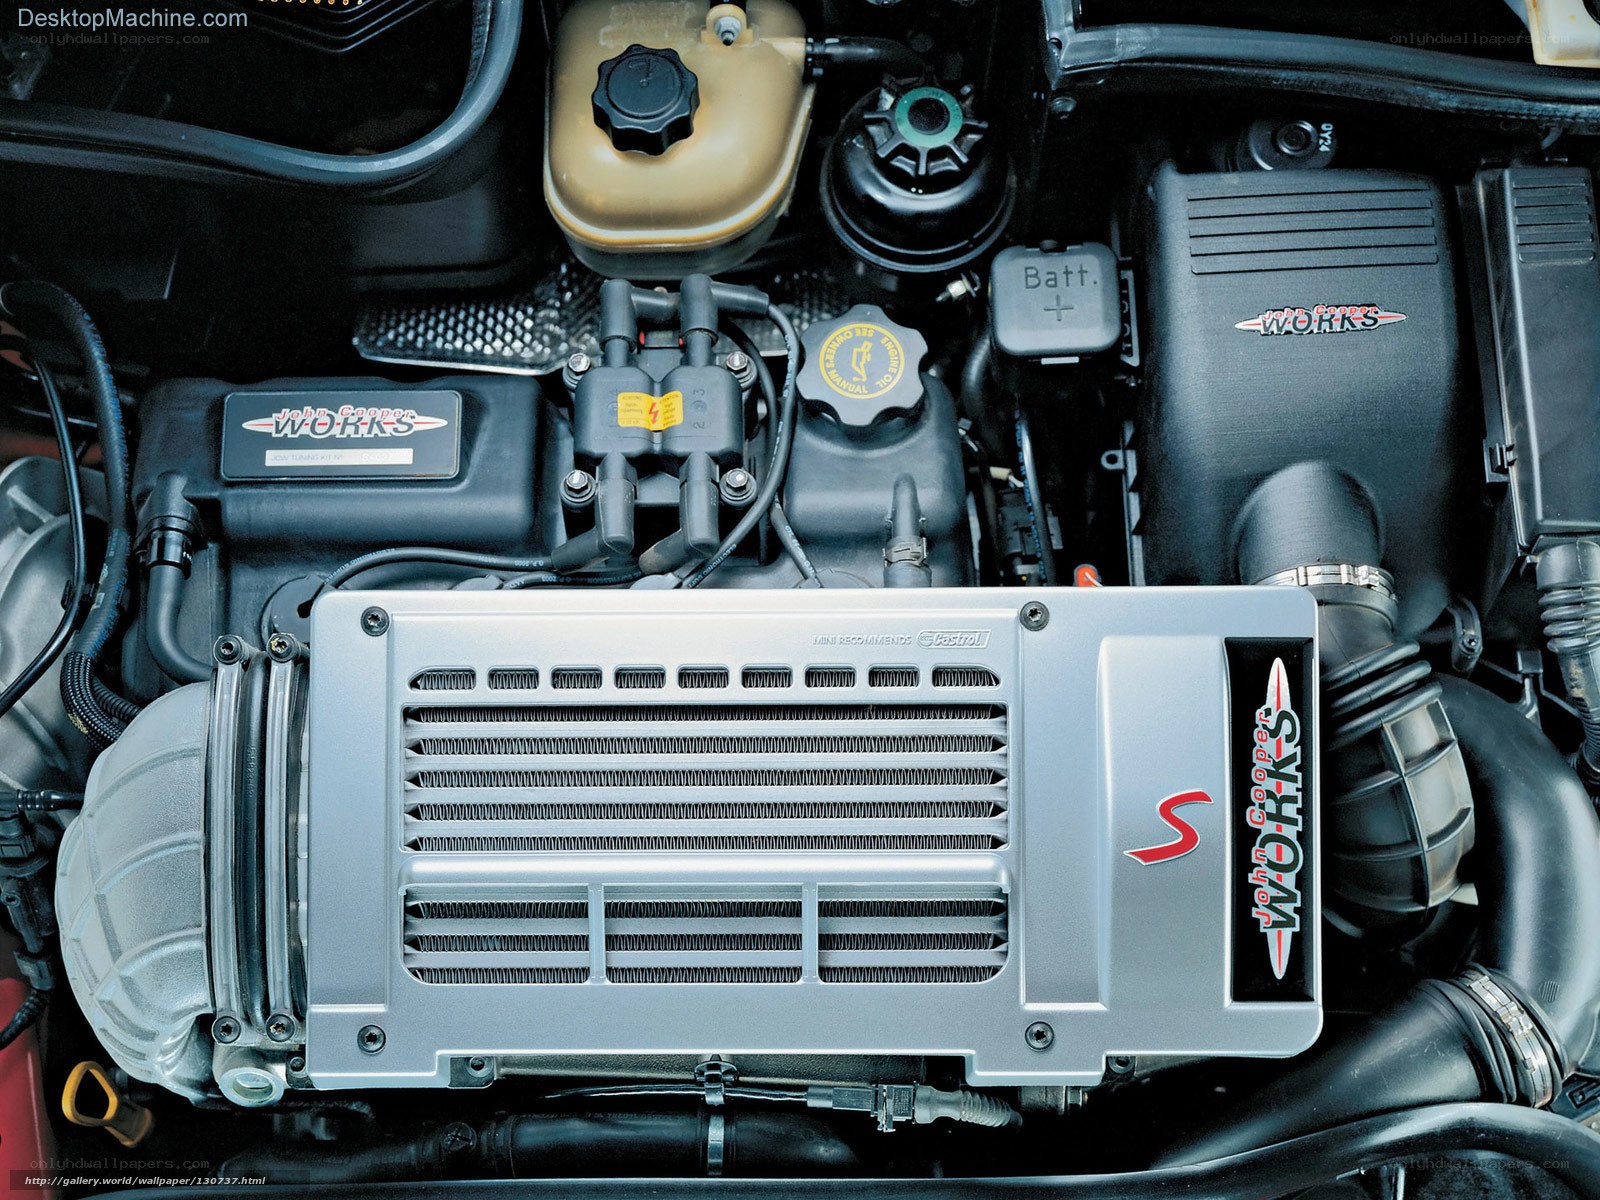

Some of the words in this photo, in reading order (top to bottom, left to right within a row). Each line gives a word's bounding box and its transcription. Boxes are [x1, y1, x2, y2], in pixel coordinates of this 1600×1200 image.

[1024, 264, 1098, 289] Batt.
[854, 327, 875, 338] SEE
[1261, 310, 1380, 334] WORKS
[879, 336, 899, 374] ENGINE
[827, 368, 869, 394] MANUAL
[875, 374, 893, 388] OIL
[274, 412, 416, 437] WORKS
[276, 407, 328, 420] John
[340, 405, 414, 420] Cooper
[812, 634, 837, 646] MINI
[839, 634, 912, 646] RECOMMENDS
[932, 632, 981, 647] Castrol
[1249, 711, 1273, 826] Cooper
[1123, 788, 1214, 866] S
[1259, 708, 1301, 931] WORKS
[1250, 847, 1272, 927] John
